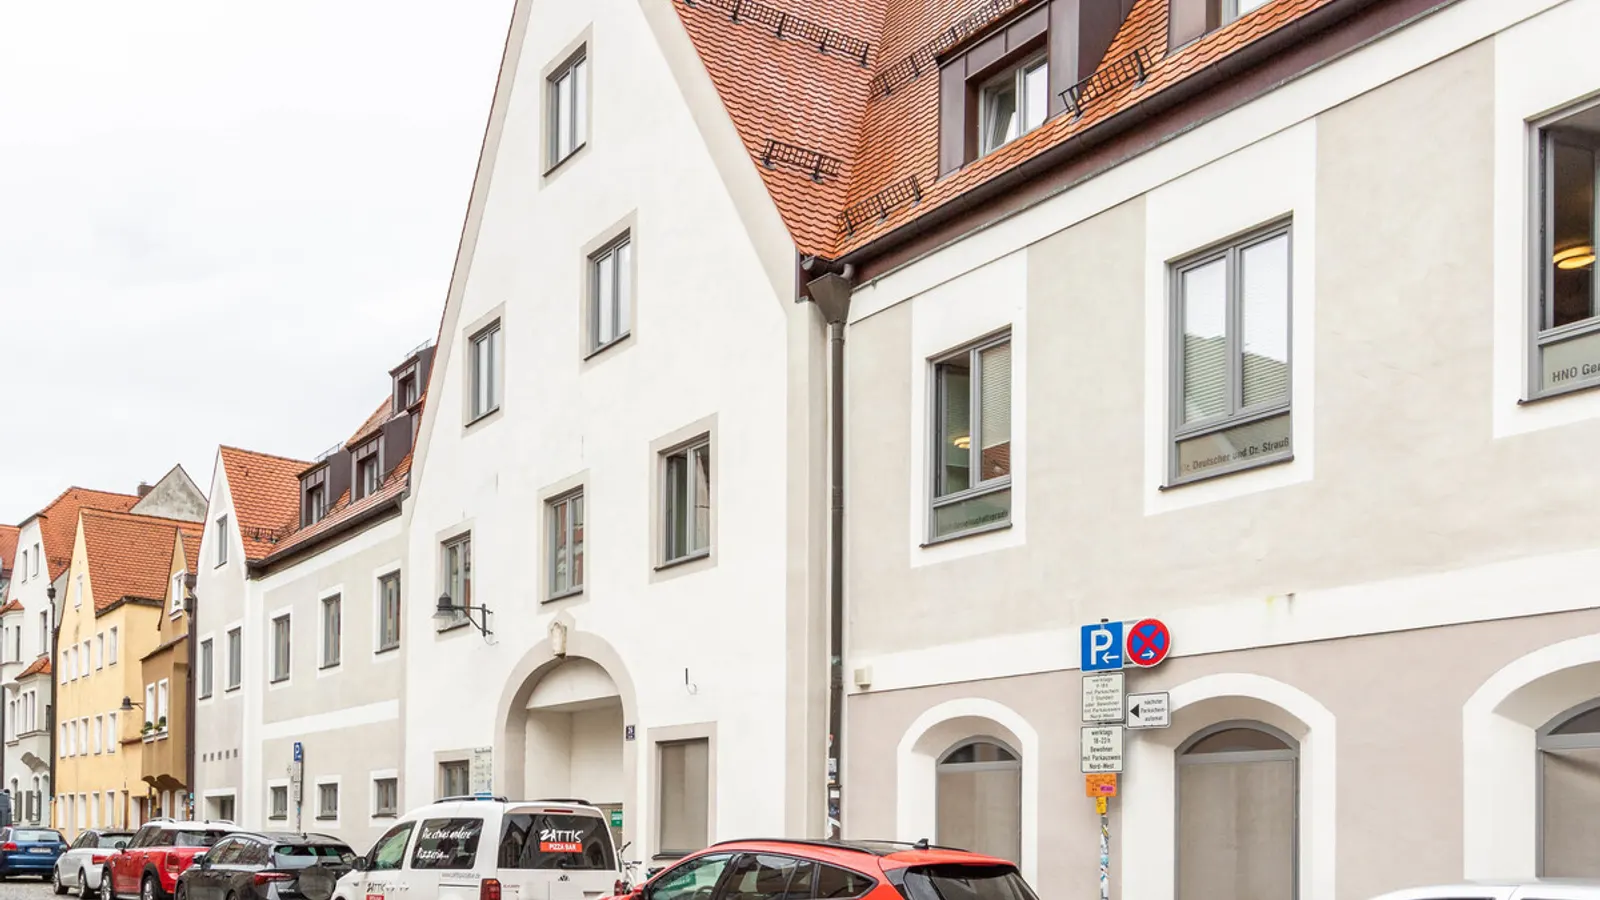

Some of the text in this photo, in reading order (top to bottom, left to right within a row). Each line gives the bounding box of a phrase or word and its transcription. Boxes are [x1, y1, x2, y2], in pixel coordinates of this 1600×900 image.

[1552, 366, 1578, 382] HNO
[1193, 454, 1230, 470] Deutscher
[1232, 447, 1247, 461] und
[1249, 445, 1261, 456] Dr.
[1262, 437, 1289, 452] Strauß
[1091, 629, 1113, 665] P
[1091, 729, 1113, 737] werktags
[1090, 745, 1113, 753] Bewohner
